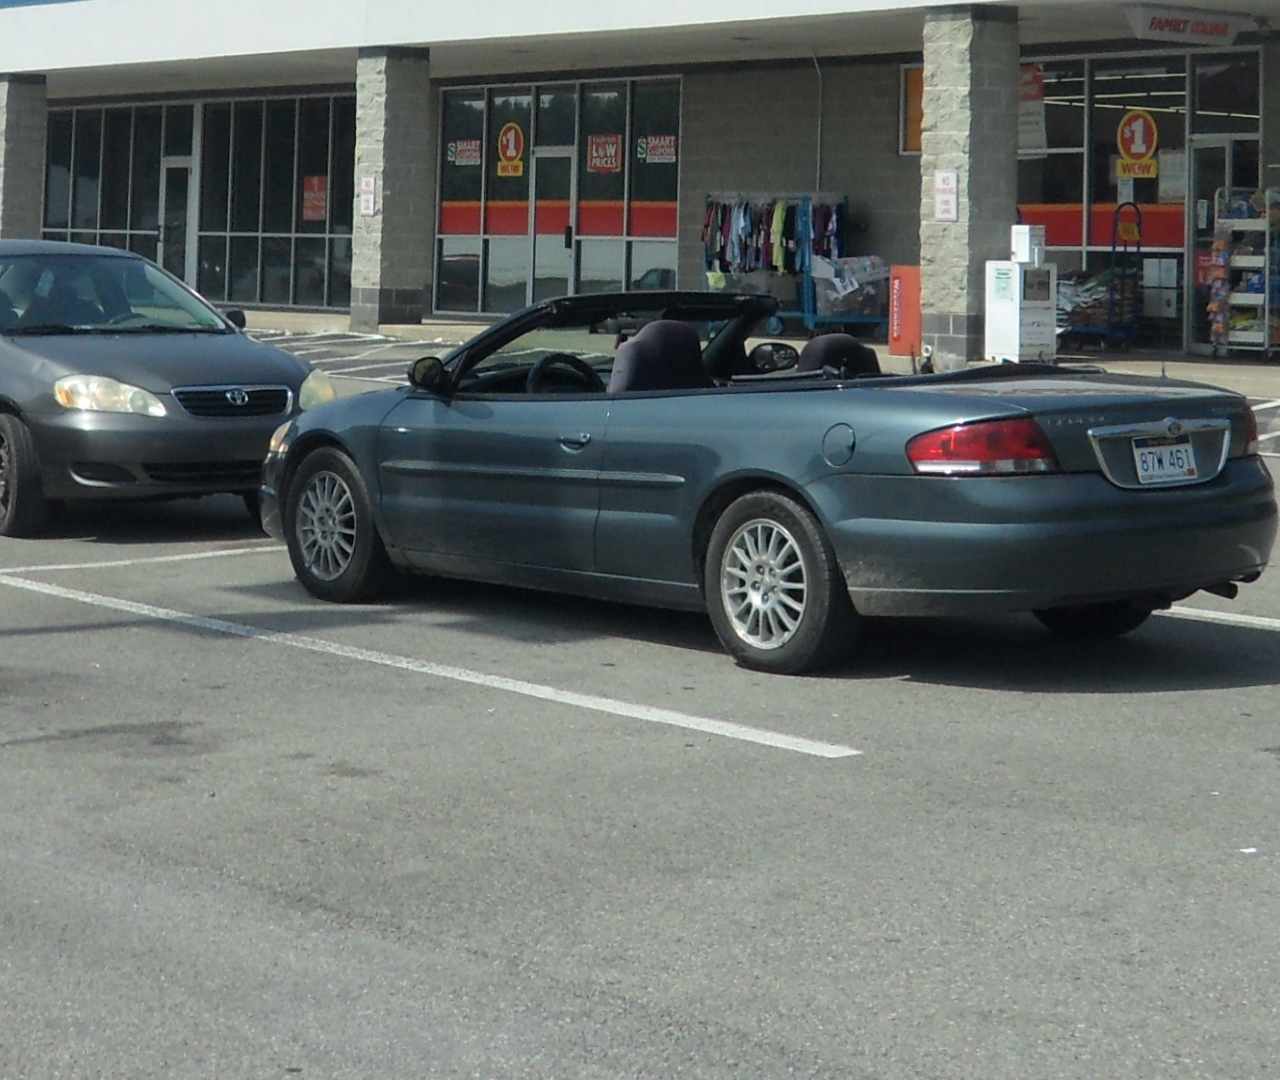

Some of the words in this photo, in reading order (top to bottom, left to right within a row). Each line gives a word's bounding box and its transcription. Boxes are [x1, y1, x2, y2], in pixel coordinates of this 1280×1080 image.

[1148, 16, 1190, 34] FAMILY
[647, 135, 676, 147] SMART
[1123, 117, 1147, 154] $1
[592, 143, 617, 158] LOW
[591, 157, 617, 168] PRICES
[1121, 162, 1152, 175] WOW
[1139, 450, 1165, 473] 87W
[1168, 448, 1192, 470] 461
